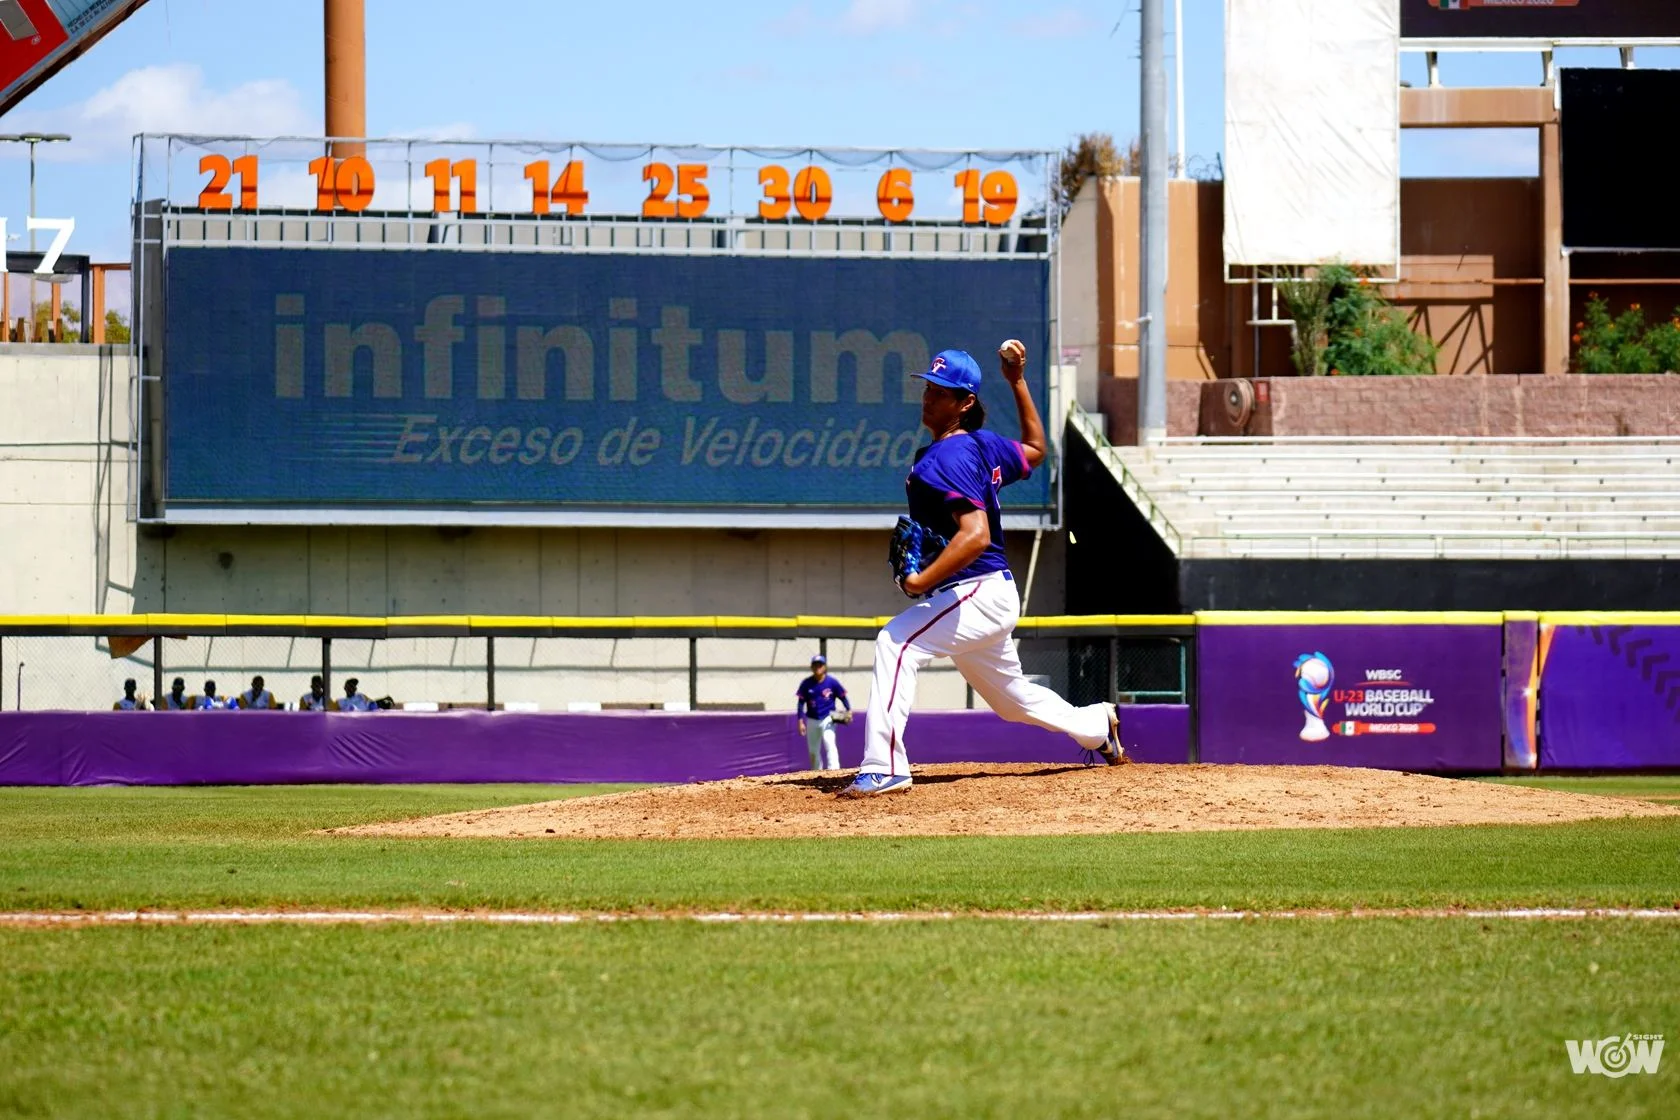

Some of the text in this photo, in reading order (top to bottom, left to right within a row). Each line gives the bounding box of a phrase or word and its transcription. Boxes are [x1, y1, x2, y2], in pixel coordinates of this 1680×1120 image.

[199, 154, 1018, 225] 21 10 11 14 25 30 6 19
[274, 294, 931, 404] infinitum
[393, 414, 927, 468] Exceso de Velocidad
[1365, 669, 1402, 680] WBSC
[1334, 689, 1434, 703] U-23 BASEBALL
[1344, 702, 1424, 717] WORLD CUP
